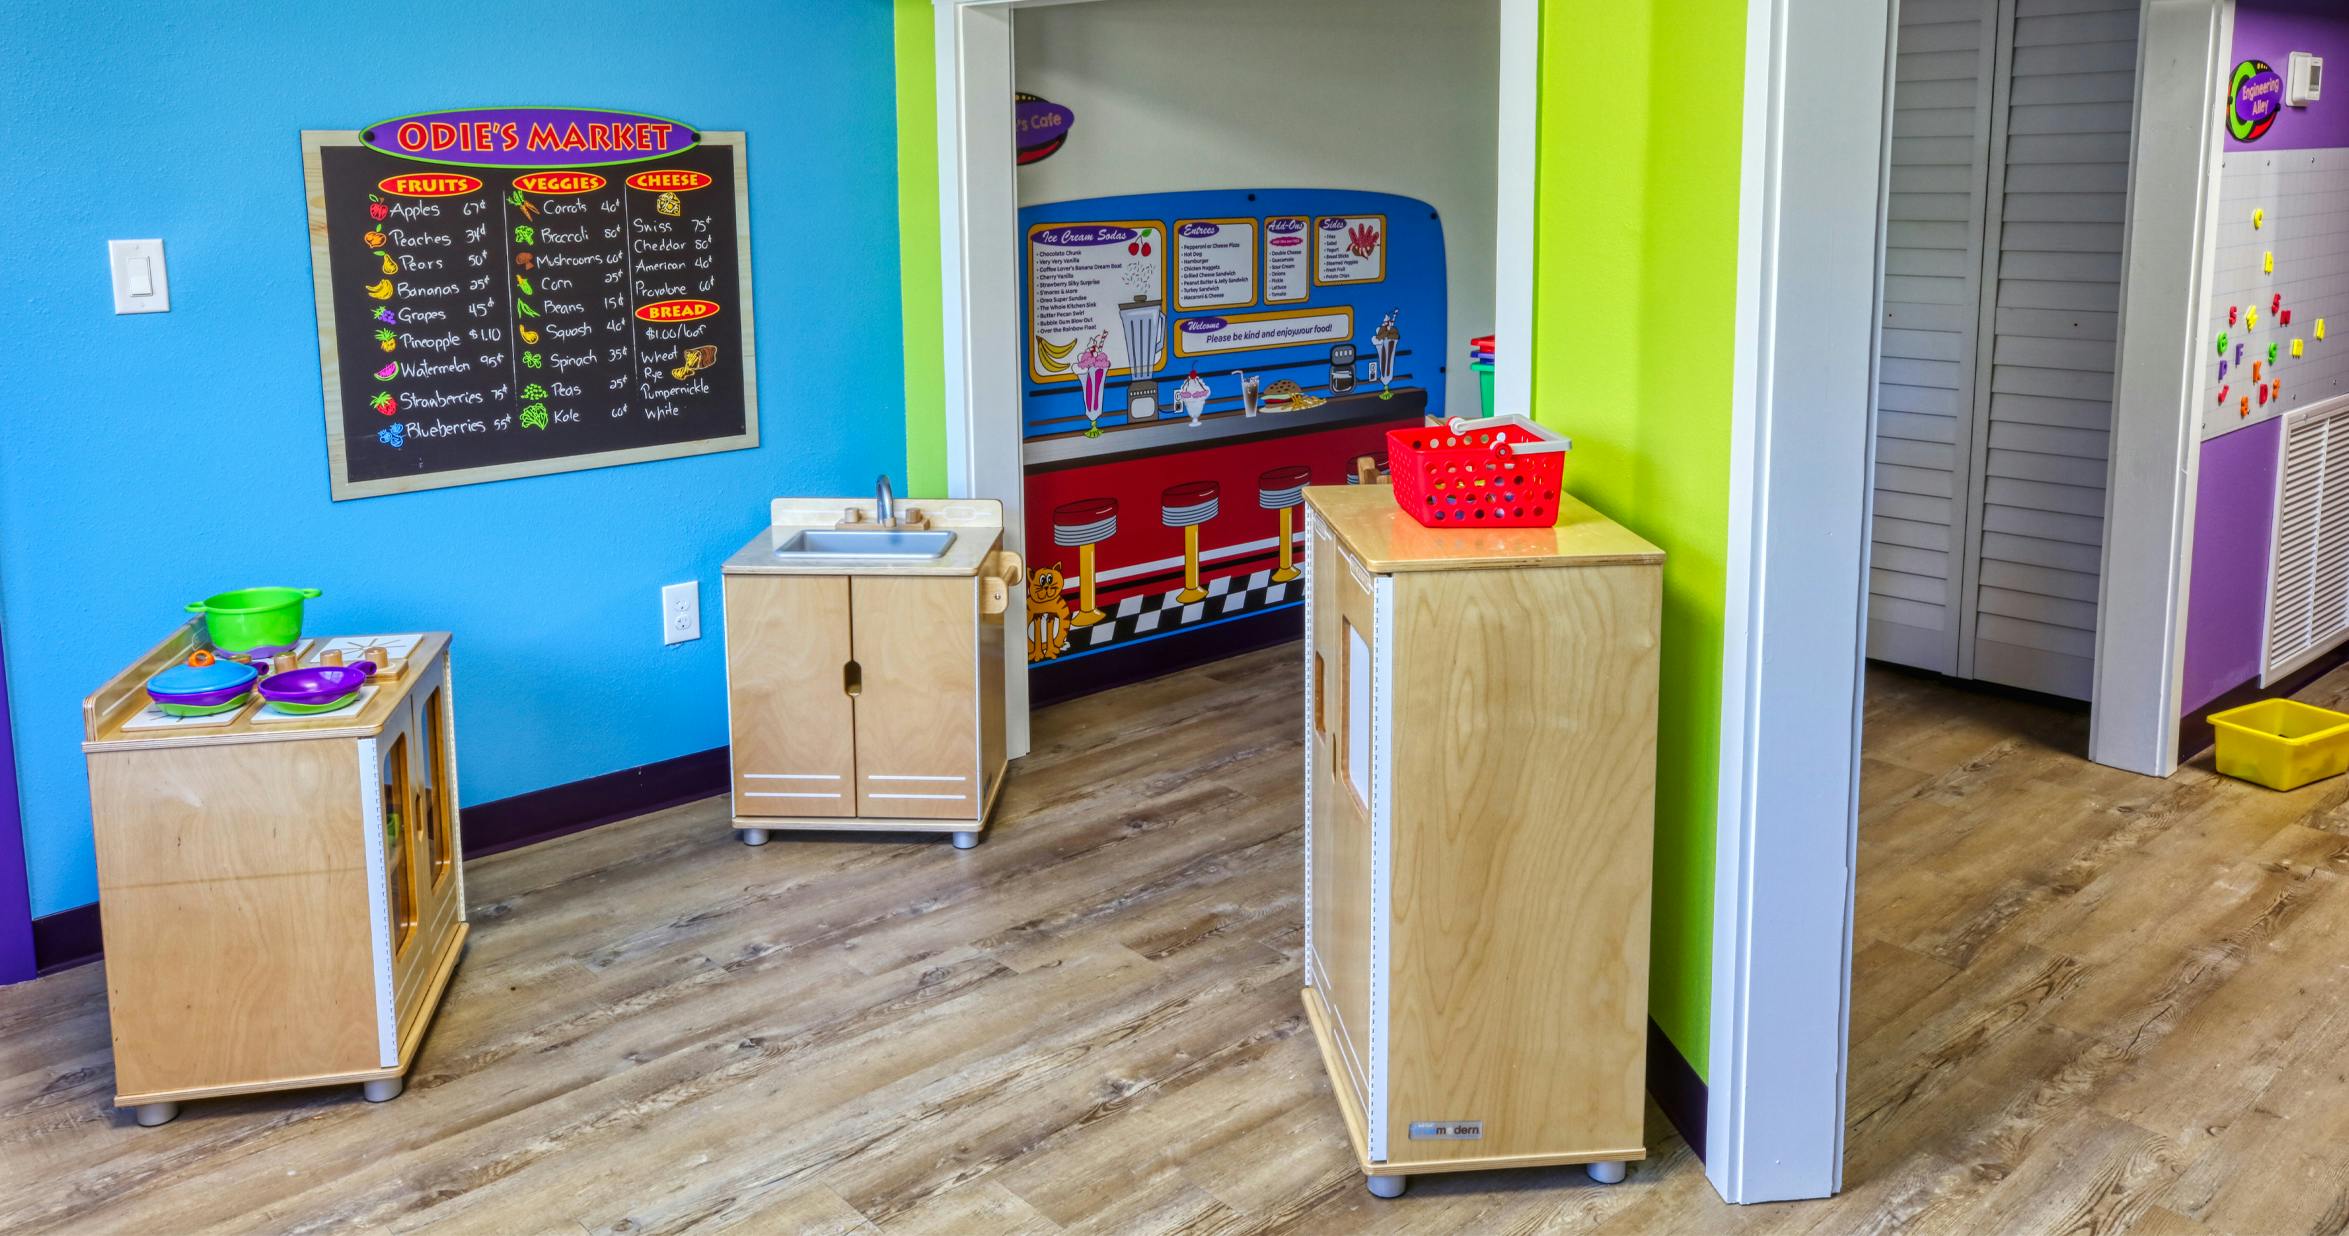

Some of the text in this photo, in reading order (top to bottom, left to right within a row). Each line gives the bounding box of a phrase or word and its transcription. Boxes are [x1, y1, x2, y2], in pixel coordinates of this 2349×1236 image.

[2242, 78, 2280, 101] Engineering
[2252, 99, 2269, 116] Alley
[1031, 112, 1062, 129] Cafe
[397, 121, 672, 152] ODIE'S MARKET
[396, 178, 468, 193] FRUITS
[522, 177, 599, 190] VEGGIES
[636, 174, 699, 187] CHEESE
[390, 200, 440, 221] Apples
[543, 198, 587, 214] Carrots
[633, 218, 672, 233] Swiss
[1183, 224, 1216, 236] Entrees
[1268, 219, 1304, 231] Add-Ons
[1323, 218, 1344, 229] Sides
[389, 229, 452, 246] Peaches
[541, 225, 589, 243] Broccoli
[1042, 228, 1127, 244] Ice Cream Sodas
[634, 238, 687, 253] Cheddar
[399, 255, 443, 271] Pears
[536, 253, 603, 269] Mushrooms
[635, 259, 687, 272] American
[397, 282, 460, 299] Bananas
[541, 277, 573, 290] Corn
[398, 307, 446, 324] Grapes
[544, 300, 584, 314] Beans
[649, 304, 706, 319] BREAD
[546, 322, 592, 343] Squash
[1187, 320, 1220, 331] Welcome
[1206, 334, 1231, 344] Please
[1233, 332, 1243, 341] be
[1244, 330, 1260, 340] kind
[1261, 328, 1275, 338] and
[1314, 324, 1333, 334] food!
[400, 332, 460, 352] Pineapple
[550, 348, 597, 373] Spinach
[641, 345, 678, 363] Wheat
[400, 356, 470, 378] Watermelon
[644, 366, 663, 383] Rye
[551, 382, 581, 397] Peas
[640, 377, 709, 400] Pumpernickle
[400, 390, 483, 410] Strawberries
[645, 402, 679, 421] White
[406, 418, 486, 438] Blueberries
